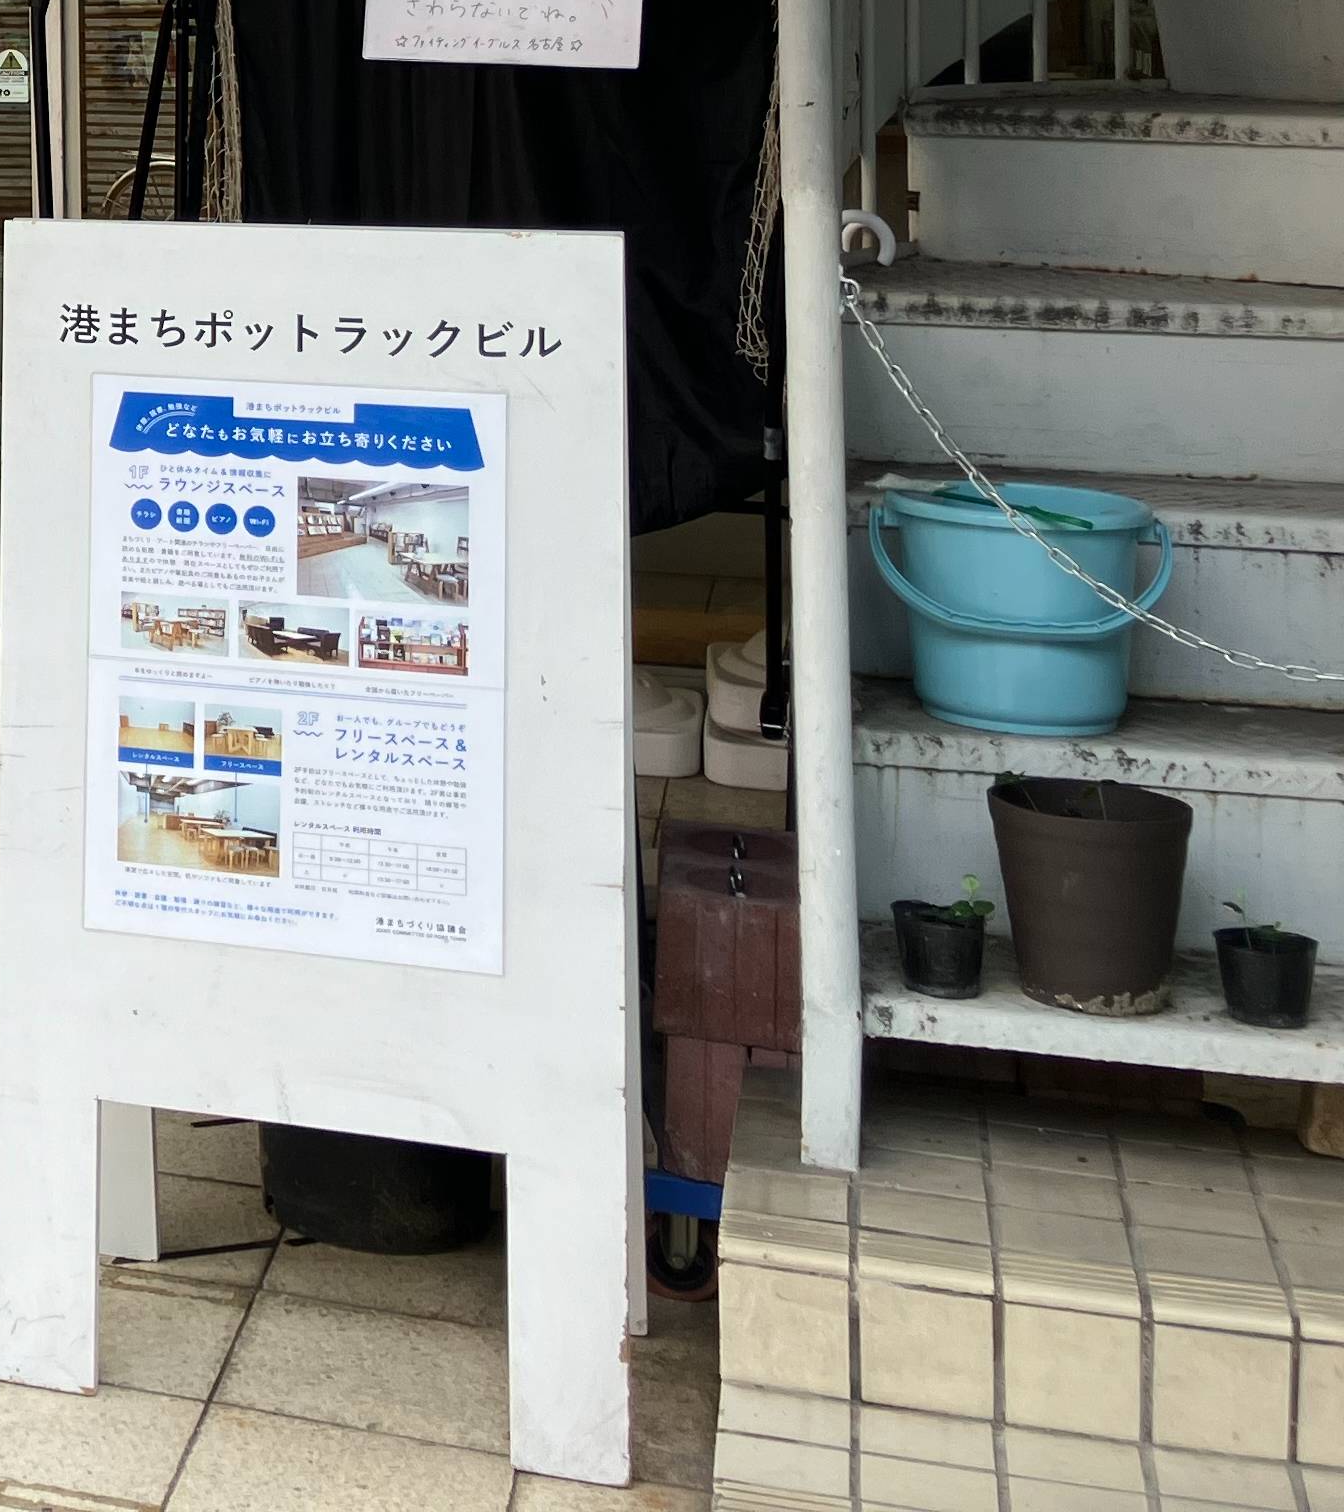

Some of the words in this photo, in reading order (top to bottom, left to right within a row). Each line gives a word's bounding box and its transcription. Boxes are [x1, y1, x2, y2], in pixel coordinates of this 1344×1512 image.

[406, 0, 577, 23] さわらないでね。
[58, 302, 563, 361] 港まちポットラックビル
[245, 401, 342, 415] 港まちポットラックビル
[165, 421, 453, 453] どなたもお気軽にお立ち寄りください
[159, 477, 286, 498] ラウンジスペース
[335, 728, 449, 751] フリースペース
[455, 739, 467, 752] &
[335, 747, 466, 771] レンタルスペース
